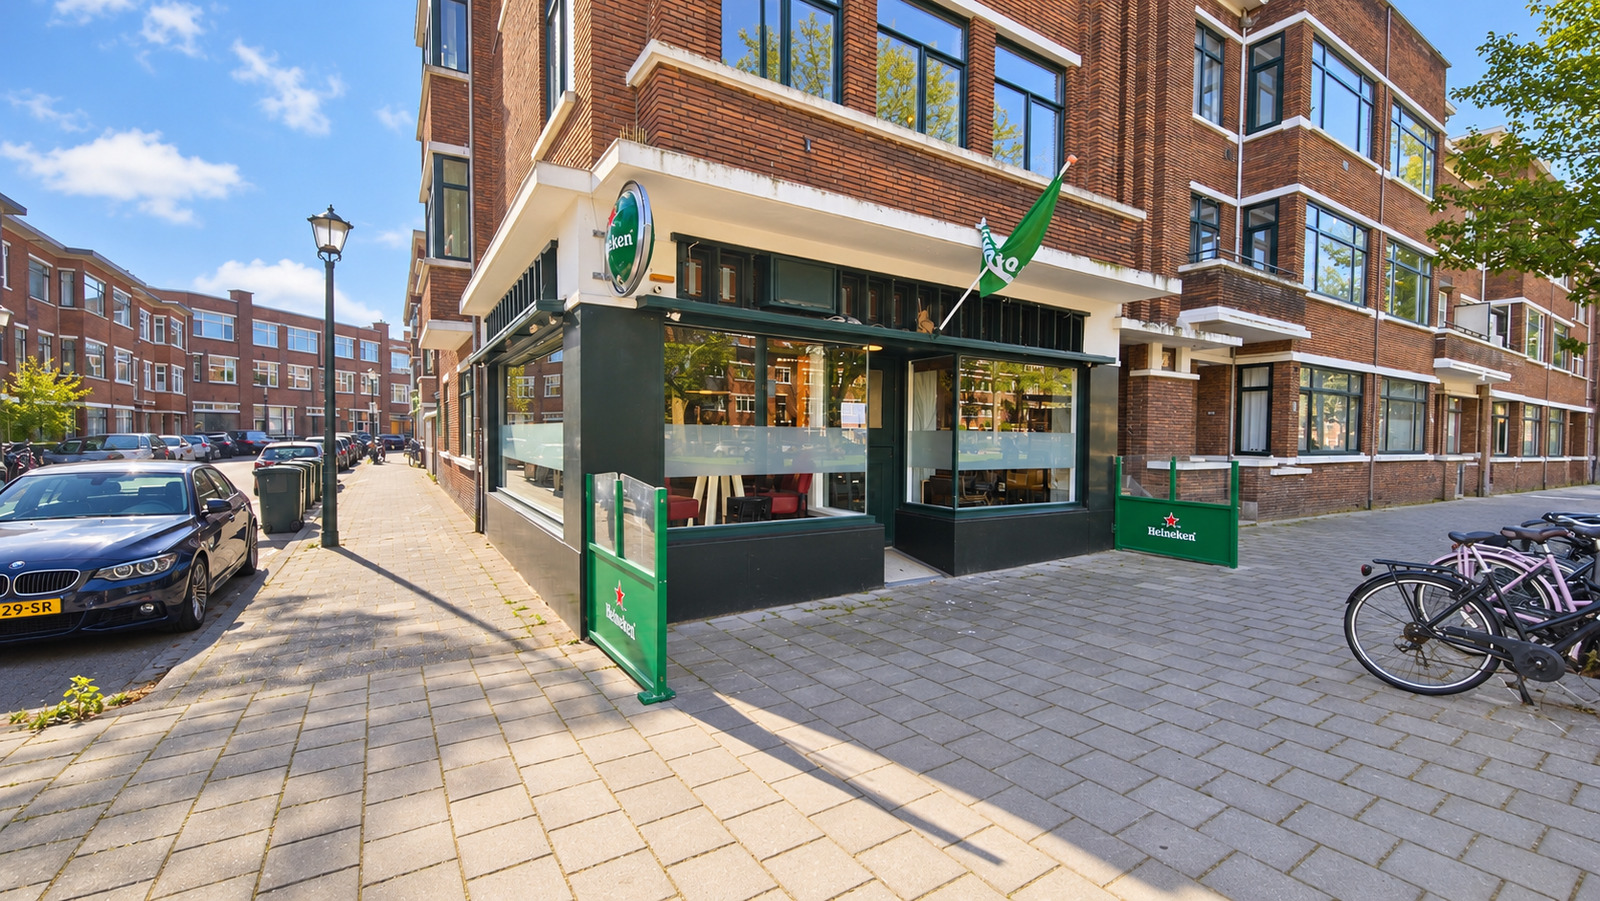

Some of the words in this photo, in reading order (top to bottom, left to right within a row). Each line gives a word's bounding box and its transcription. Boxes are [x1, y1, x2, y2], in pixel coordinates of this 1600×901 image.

[1147, 526, 1196, 542] Heineken
[2, 601, 53, 617] 29-SR
[605, 602, 636, 641] Heineken
